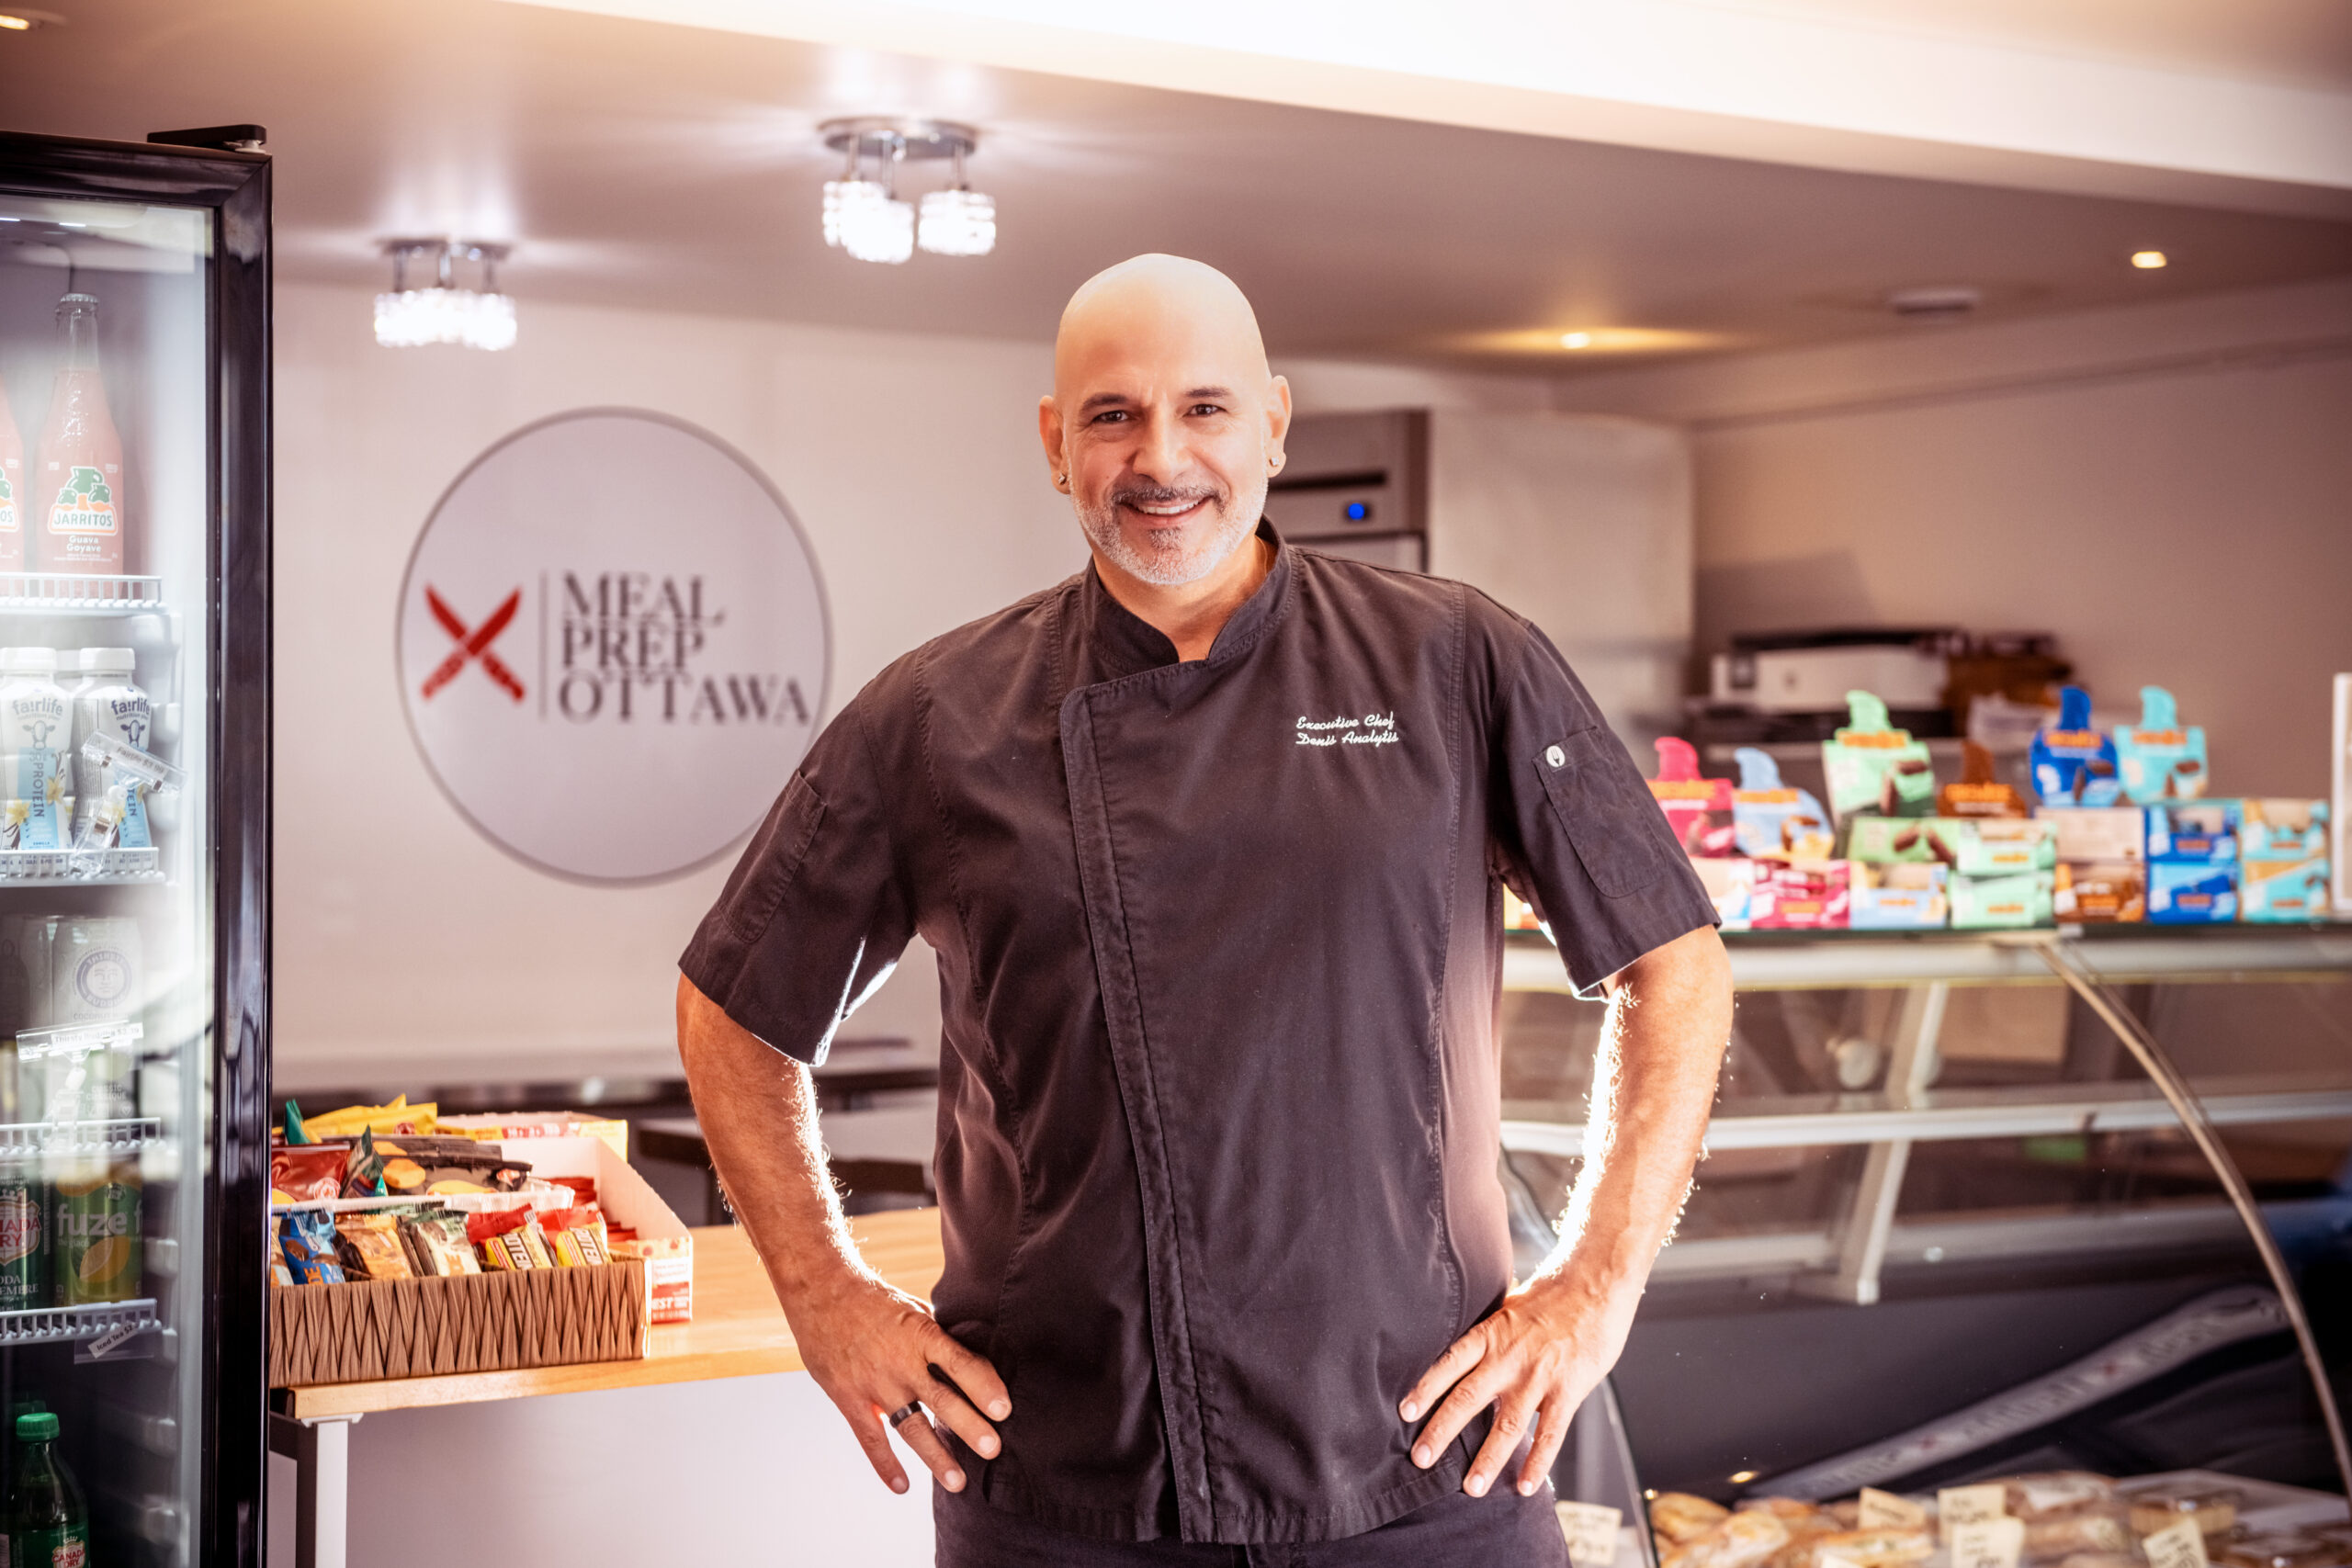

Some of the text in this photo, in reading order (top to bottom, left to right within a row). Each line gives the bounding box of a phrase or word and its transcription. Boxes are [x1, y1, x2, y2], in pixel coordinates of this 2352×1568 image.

[53, 513, 112, 527] JARRITOS
[69, 536, 99, 544] Guava
[66, 543, 101, 554] Goyave
[562, 571, 725, 625] MEAL
[561, 618, 706, 671] PREP
[559, 672, 811, 726] OTTAWA
[1296, 710, 1395, 730] Executive Chef
[1295, 732, 1337, 746] Denis
[33, 762, 44, 818] PROTEIN
[57, 1203, 127, 1237] fuze
[0, 1234, 22, 1247] RY
[0, 1284, 39, 1296] EMBRE
[52, 1550, 85, 1563] CANADA
